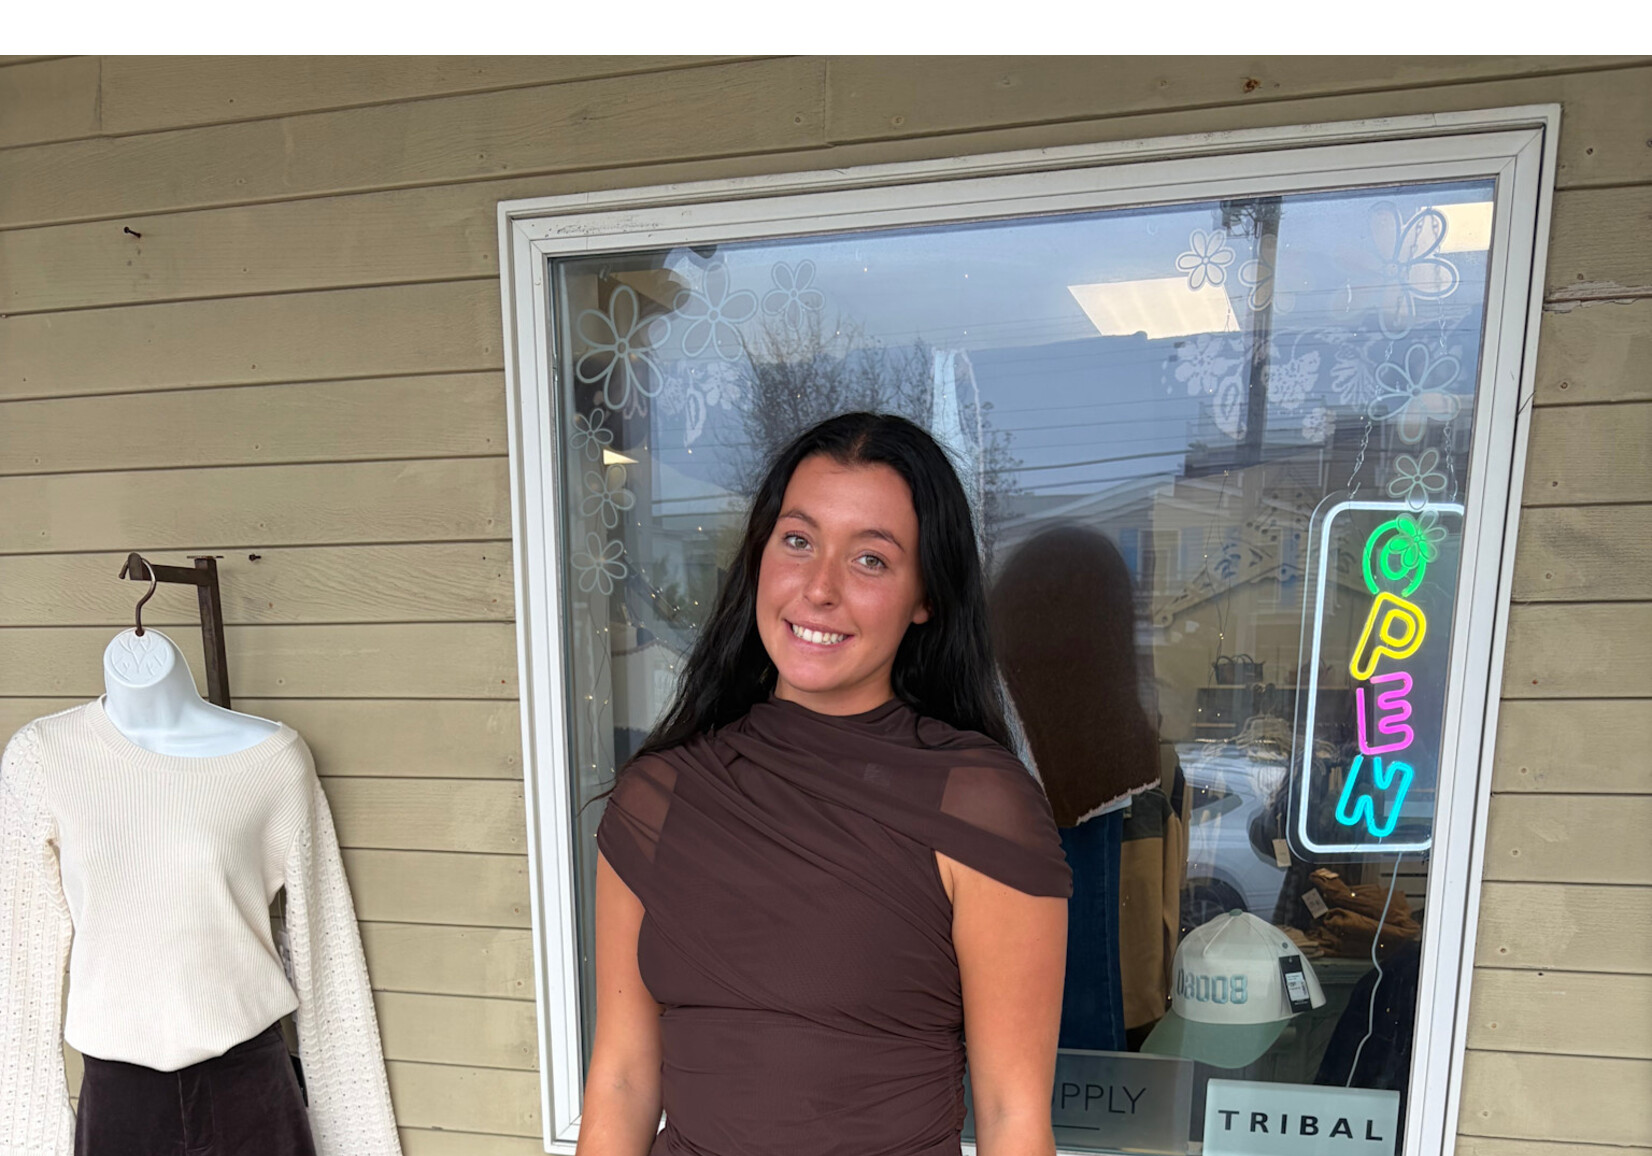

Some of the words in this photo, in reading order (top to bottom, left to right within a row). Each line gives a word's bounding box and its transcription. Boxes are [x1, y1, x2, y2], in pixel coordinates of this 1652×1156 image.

[1335, 518, 1427, 837] OPEN
[1176, 967, 1248, 1005] 08008
[1051, 1082, 1147, 1115] PPLY
[1218, 1109, 1383, 1142] TRIBAL
